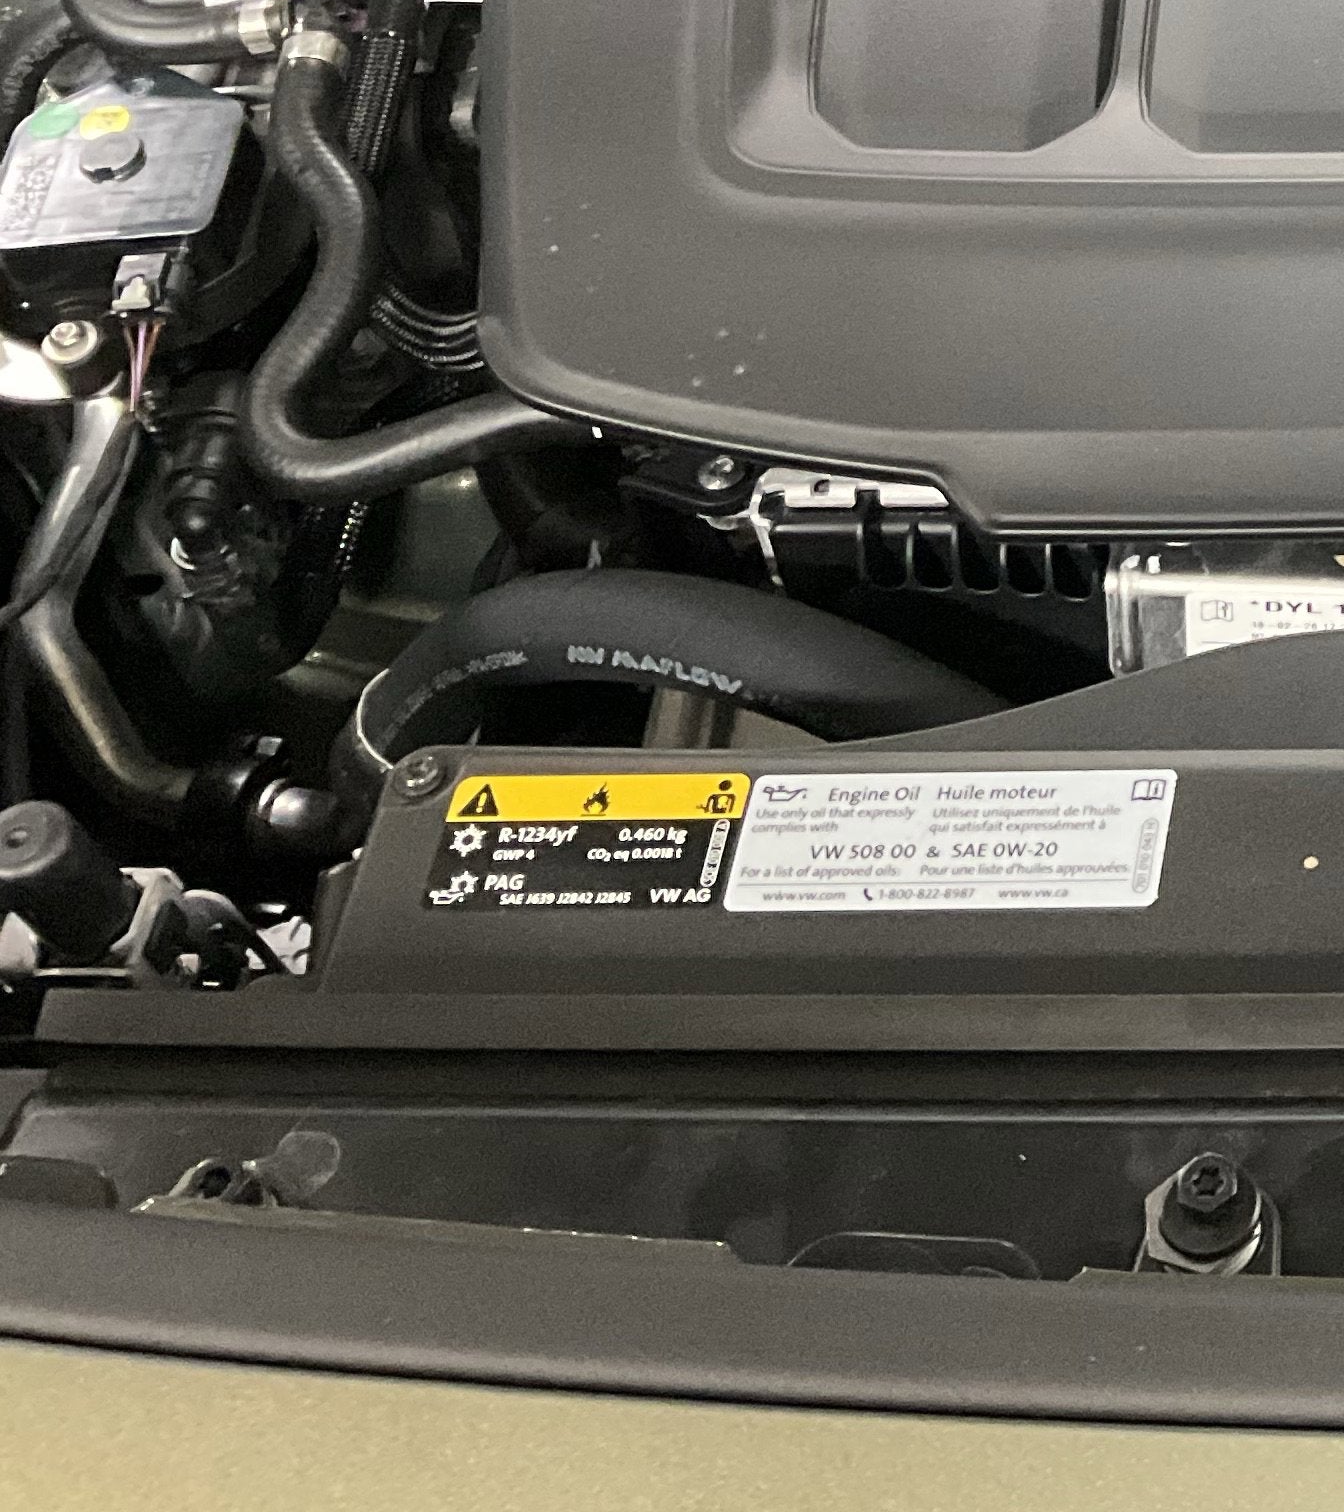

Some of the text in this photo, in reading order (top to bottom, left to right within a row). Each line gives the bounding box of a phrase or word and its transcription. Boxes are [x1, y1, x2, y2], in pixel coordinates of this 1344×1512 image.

[828, 786, 1058, 805] Engine Oil Huile moteur
[756, 807, 916, 820] Use only oil that expressly
[933, 807, 979, 819] Utilisez
[982, 807, 1060, 819] uniquement
[1064, 806, 1080, 817] de
[751, 822, 839, 835] complies with
[929, 819, 1106, 834] qui satisfait expressément à
[498, 826, 579, 846] R-1234yf
[618, 827, 688, 844] 0.460 kg
[492, 849, 535, 860] GWP 4
[613, 850, 630, 862] eq
[676, 848, 682, 859] t
[811, 841, 1058, 859] VW 508 00 & SAE 0W-20
[741, 867, 760, 877] For
[763, 869, 771, 877] a
[774, 867, 793, 877] list
[796, 866, 810, 877] of
[814, 865, 873, 879] approved
[920, 865, 948, 875] Pour
[952, 866, 975, 875] une
[978, 864, 1003, 875] liste
[484, 874, 525, 891] PAG
[500, 893, 524, 905] SAE
[650, 888, 712, 903] VW AG
[763, 891, 846, 901] www.vw.com
[998, 889, 1068, 898] www.vw.ca
